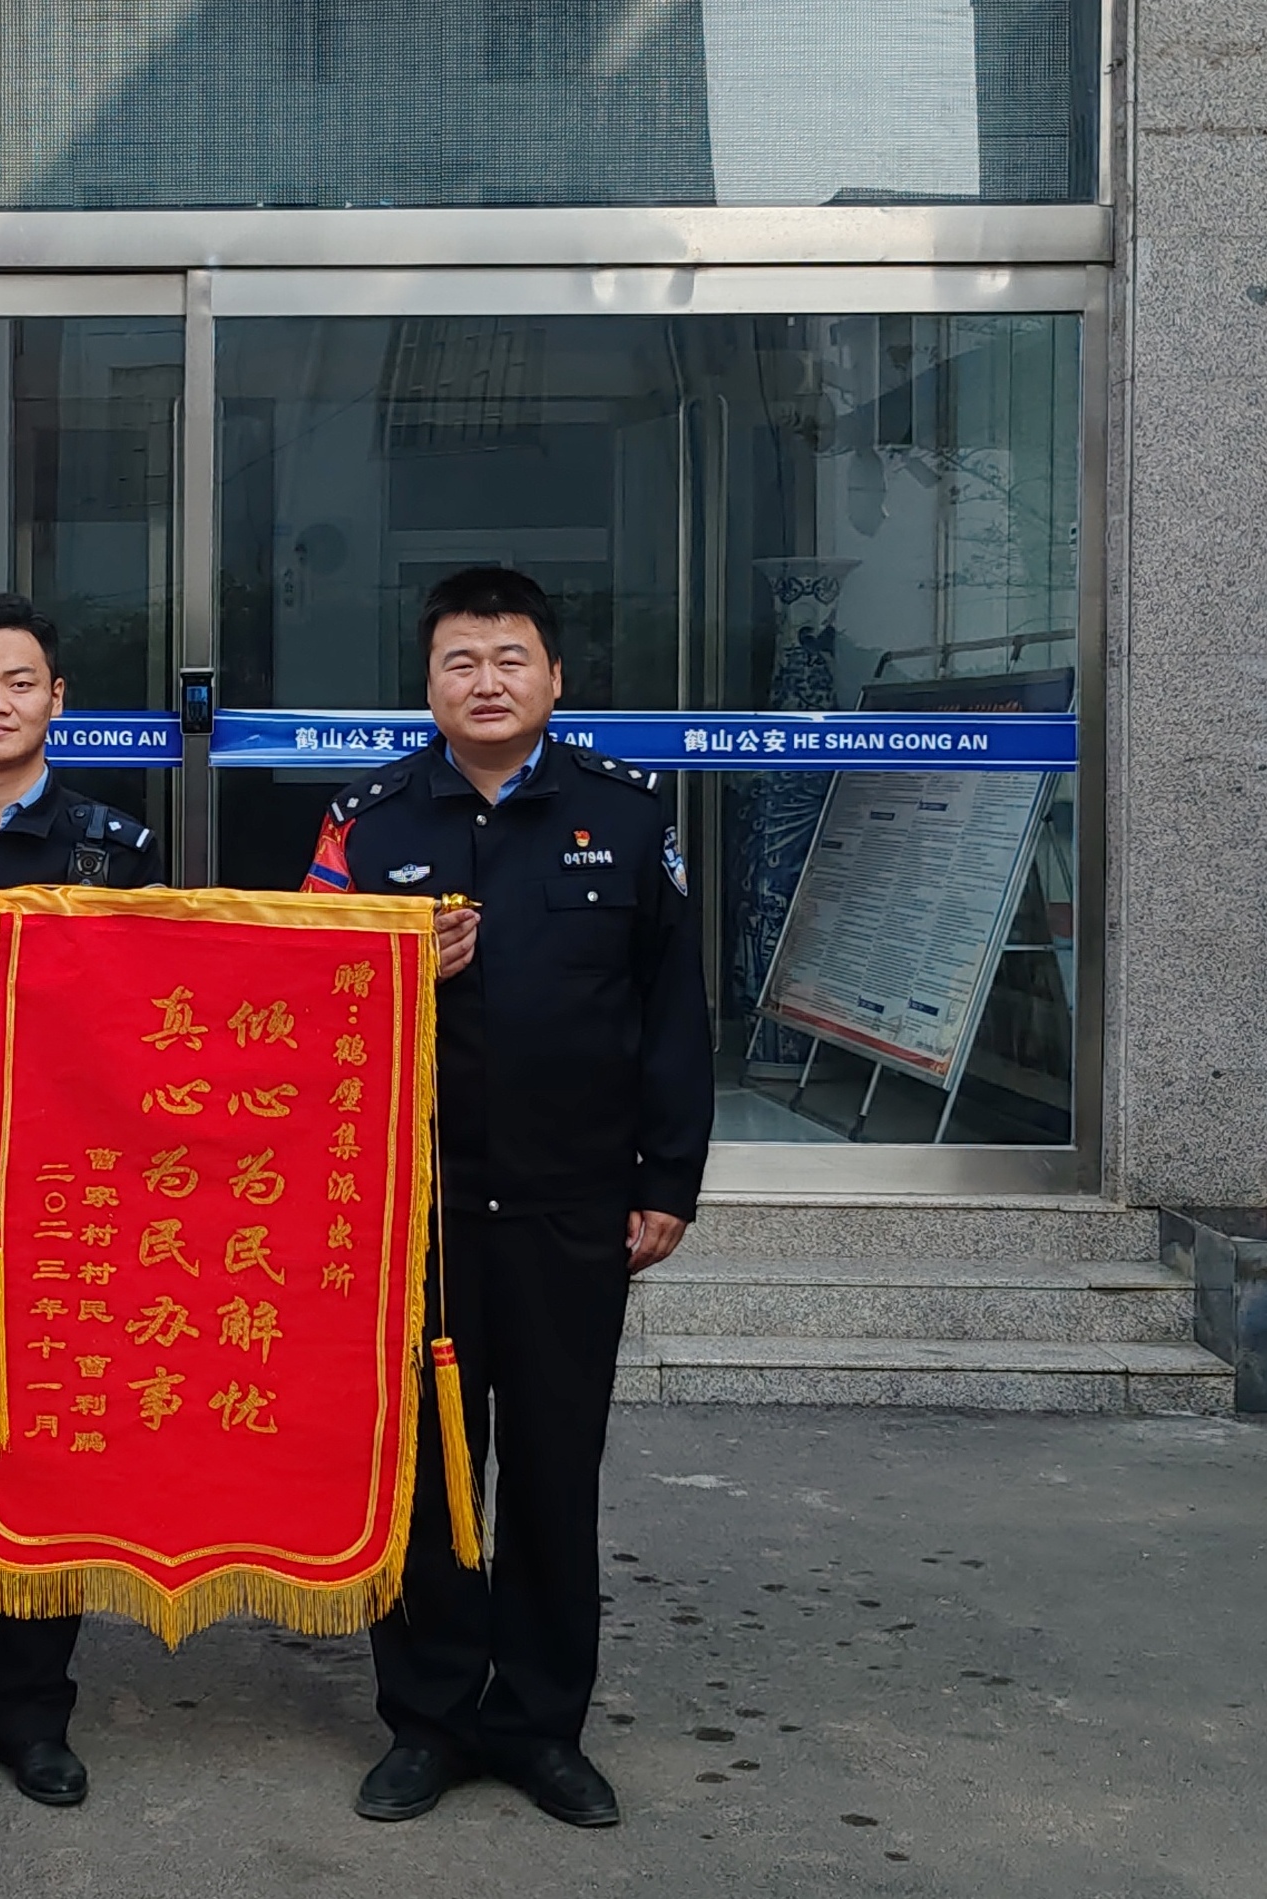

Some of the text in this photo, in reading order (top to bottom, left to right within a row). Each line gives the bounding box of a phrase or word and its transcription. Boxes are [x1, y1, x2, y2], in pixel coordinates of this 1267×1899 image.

[73, 730, 133, 746] GONG
[137, 731, 167, 746] AN
[295, 727, 395, 751] 鹤山公安
[402, 731, 429, 747] HE
[564, 732, 593, 748] AN
[684, 729, 786, 752] 鹤山公安
[793, 733, 988, 751] HE SHAN GONG AN
[563, 850, 613, 865] 047944
[125, 986, 212, 1432] 真心为民办事
[208, 1000, 299, 1435] 倾心为民解忧
